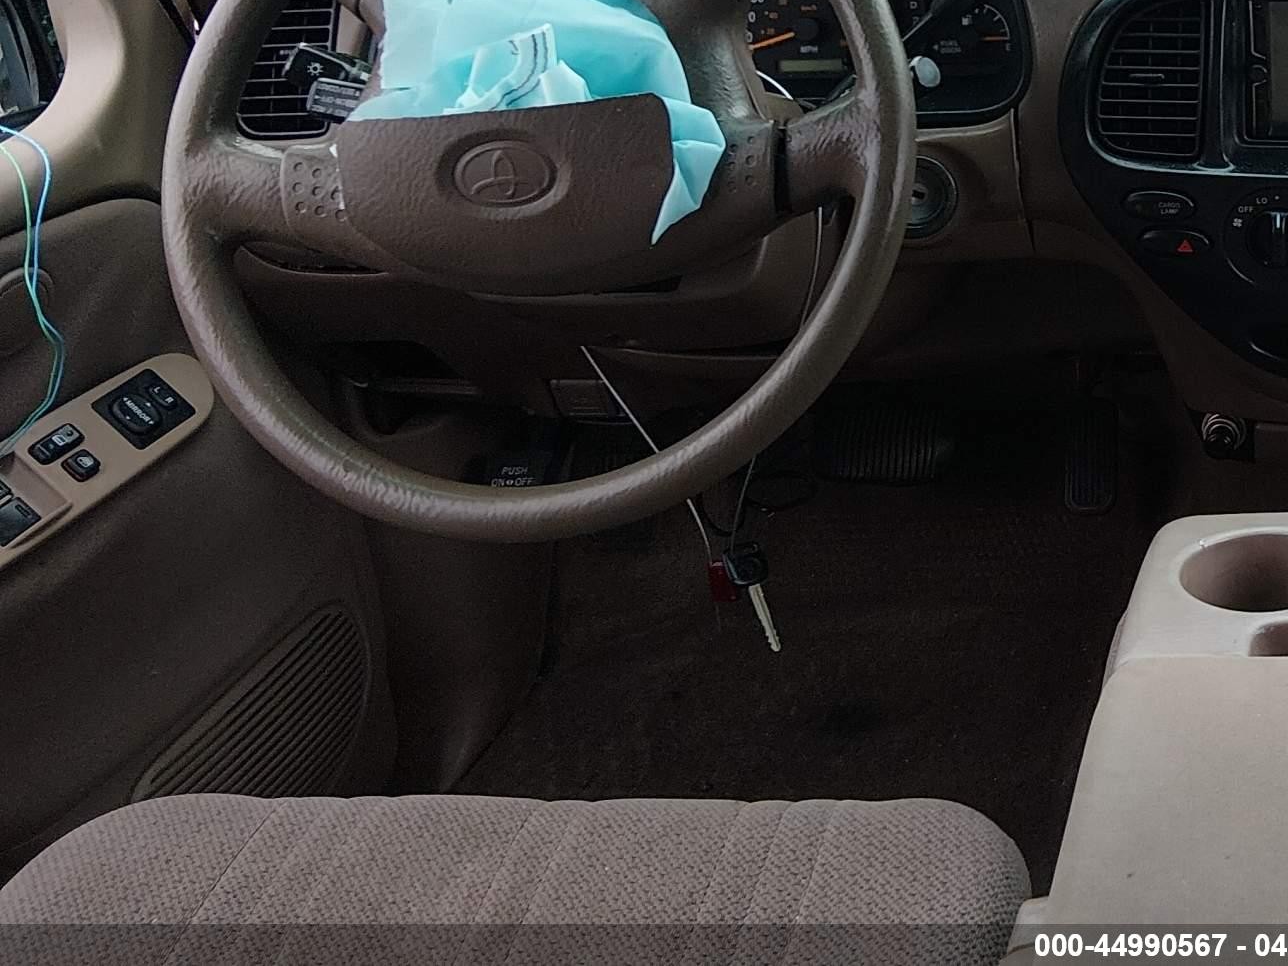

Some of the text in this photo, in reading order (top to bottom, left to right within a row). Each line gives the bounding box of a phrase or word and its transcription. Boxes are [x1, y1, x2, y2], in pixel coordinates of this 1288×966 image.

[800, 45, 818, 53] MPH
[1158, 201, 1180, 209] CARGO
[1256, 197, 1268, 205] LO
[153, 386, 161, 394] L
[164, 396, 174, 404] R
[124, 399, 152, 423] MIRROR
[501, 466, 528, 475] PUSH
